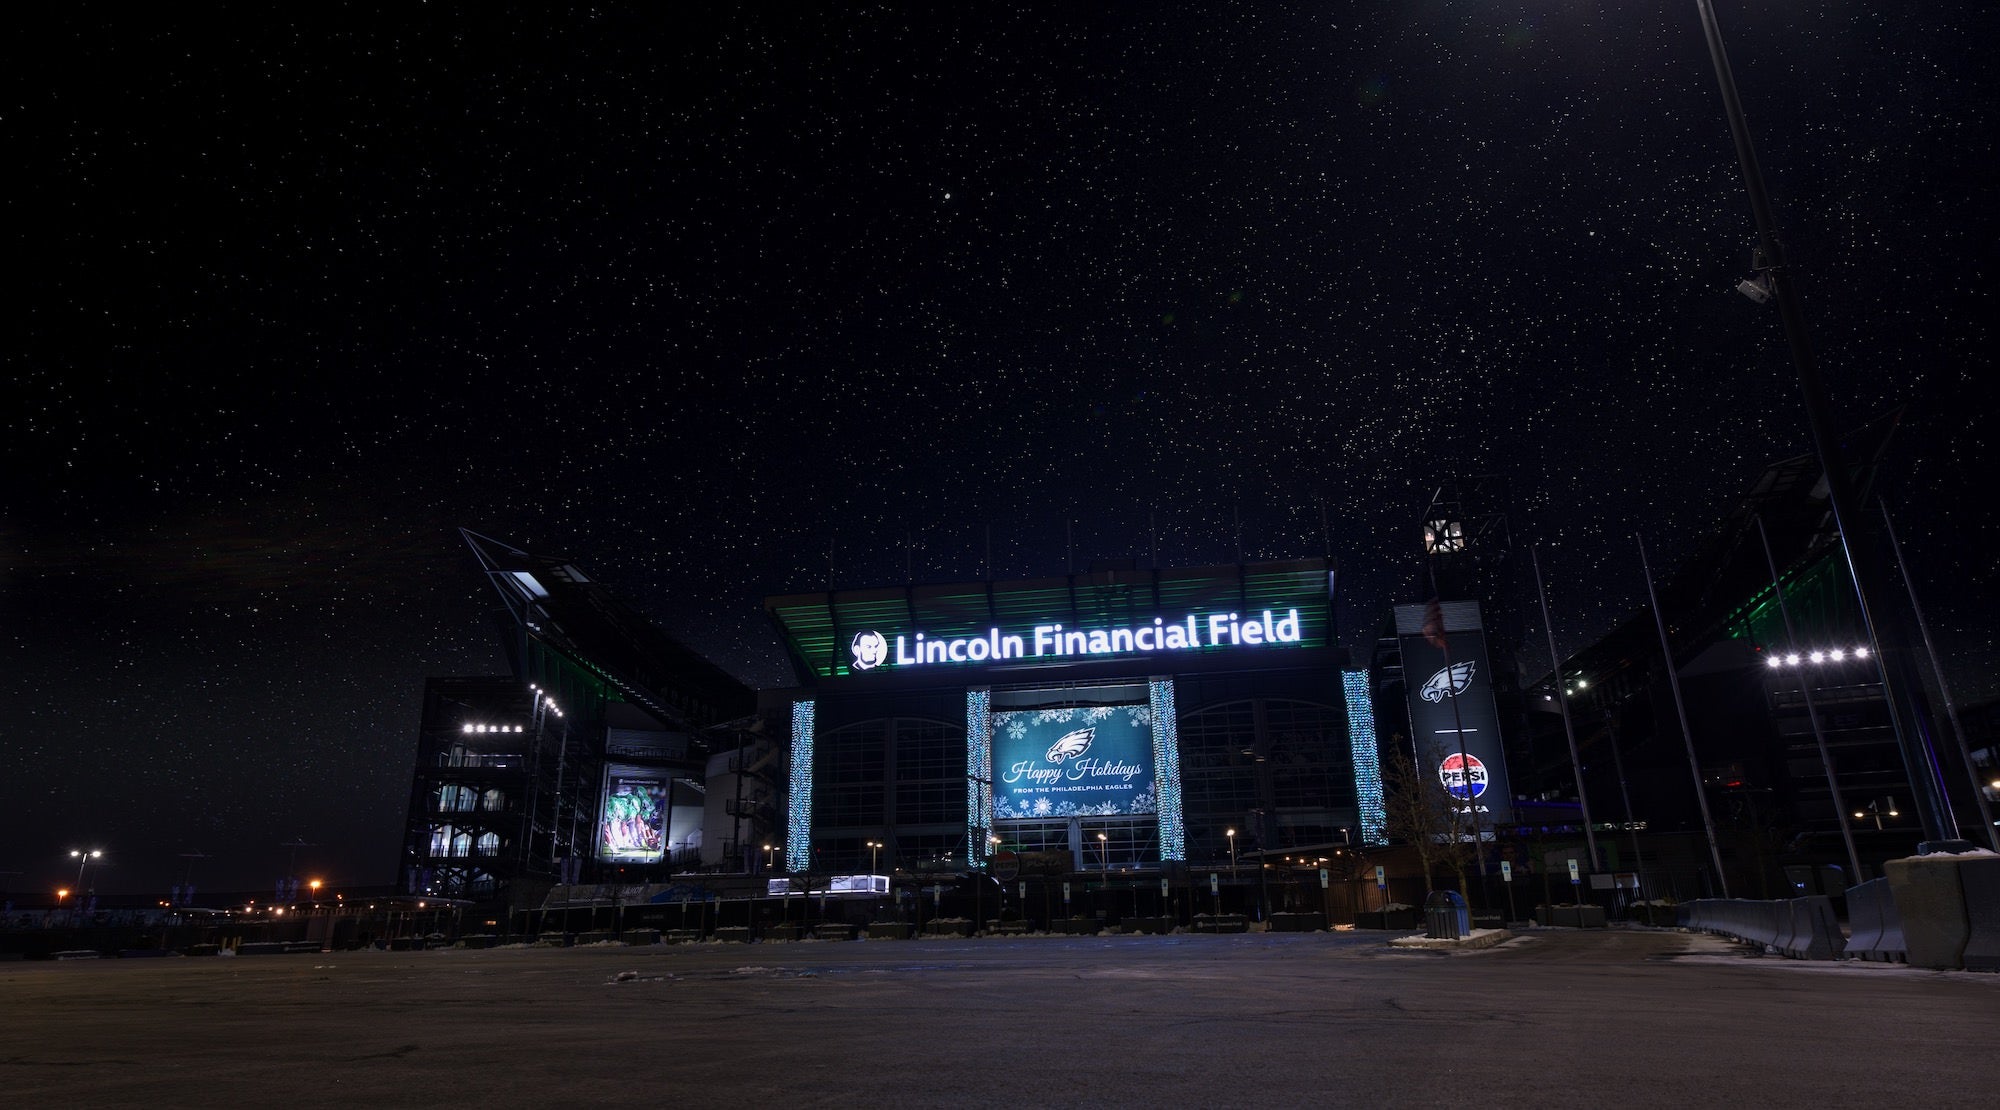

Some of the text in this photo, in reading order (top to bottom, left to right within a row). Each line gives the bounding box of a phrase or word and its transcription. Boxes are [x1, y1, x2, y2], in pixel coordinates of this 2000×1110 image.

[897, 609, 1301, 665] Lincoln Financial Field
[1002, 757, 1143, 784] Happy Holidays
[1442, 771, 1486, 781] PEPSI
